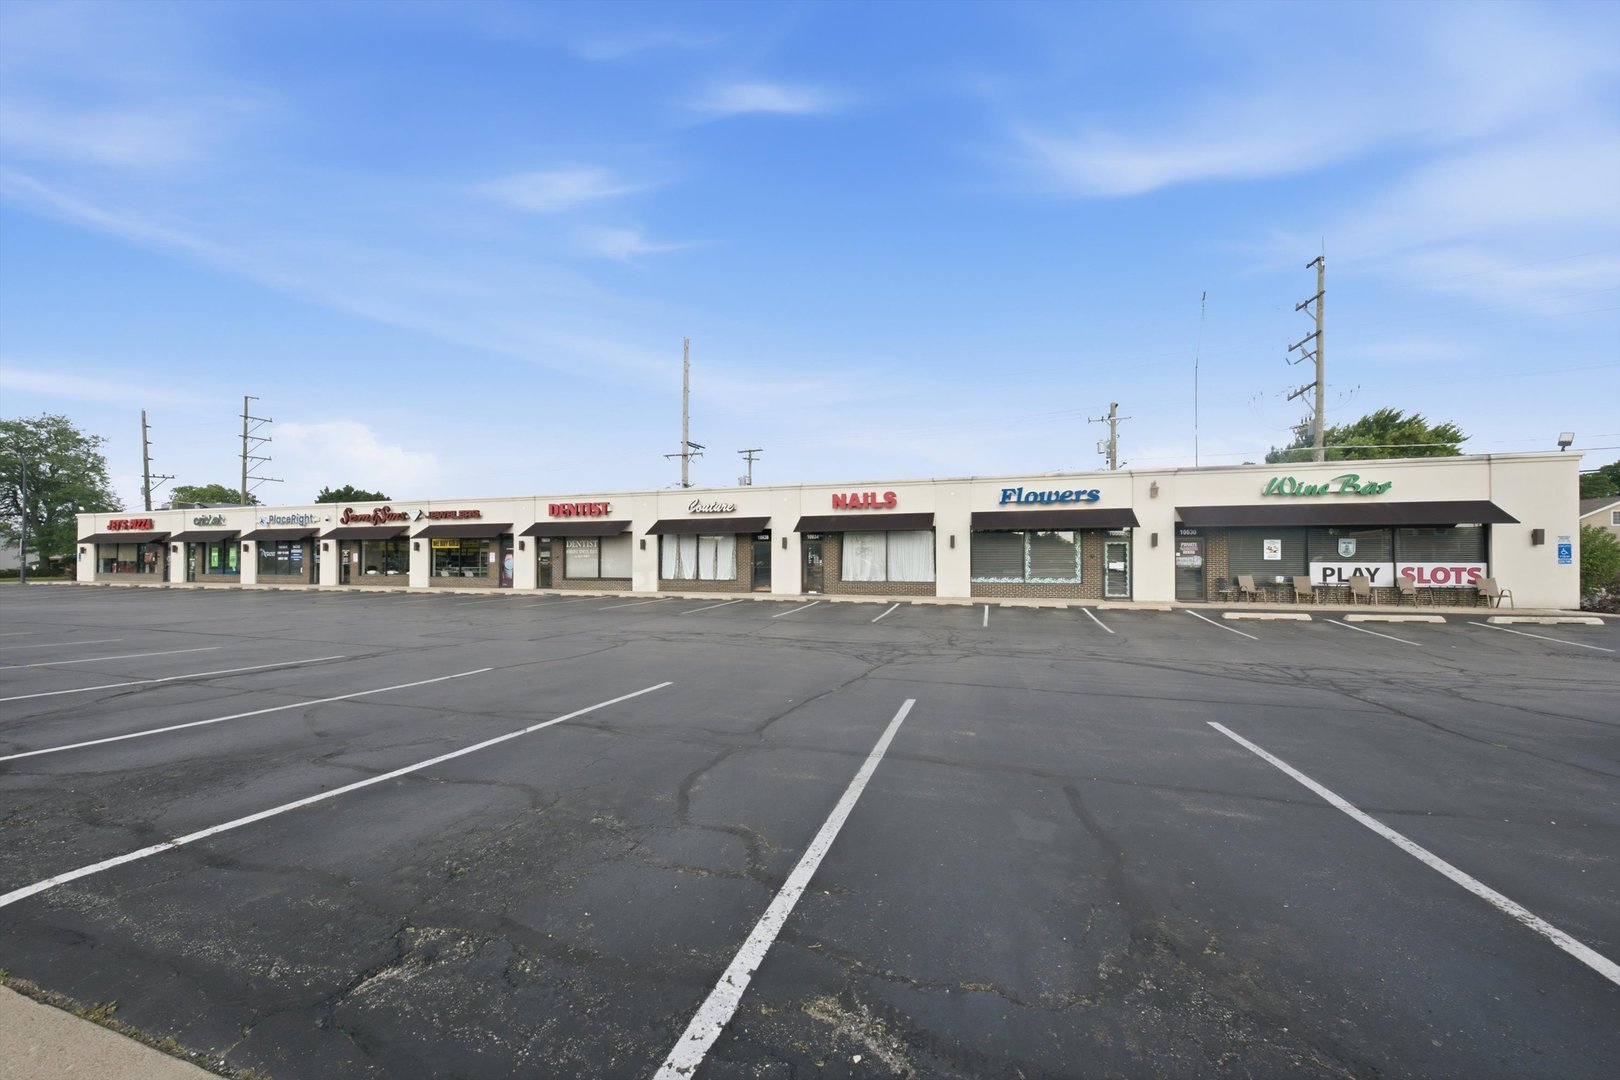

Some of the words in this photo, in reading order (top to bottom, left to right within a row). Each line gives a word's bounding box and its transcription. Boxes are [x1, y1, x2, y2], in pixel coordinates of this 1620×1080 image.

[1263, 476, 1328, 496] Wine
[1331, 474, 1392, 495] Bar
[832, 491, 897, 509] NAILS
[999, 487, 1100, 505] Flowers
[548, 502, 610, 516] DENTIST
[688, 499, 735, 513] Couture
[267, 514, 313, 526] PlaceRight
[425, 510, 481, 520] JEWELERS
[107, 520, 129, 531] JET'S
[130, 519, 153, 530] PIZZA
[1322, 567, 1380, 582] PLAY
[1401, 566, 1483, 584] SLOTS
